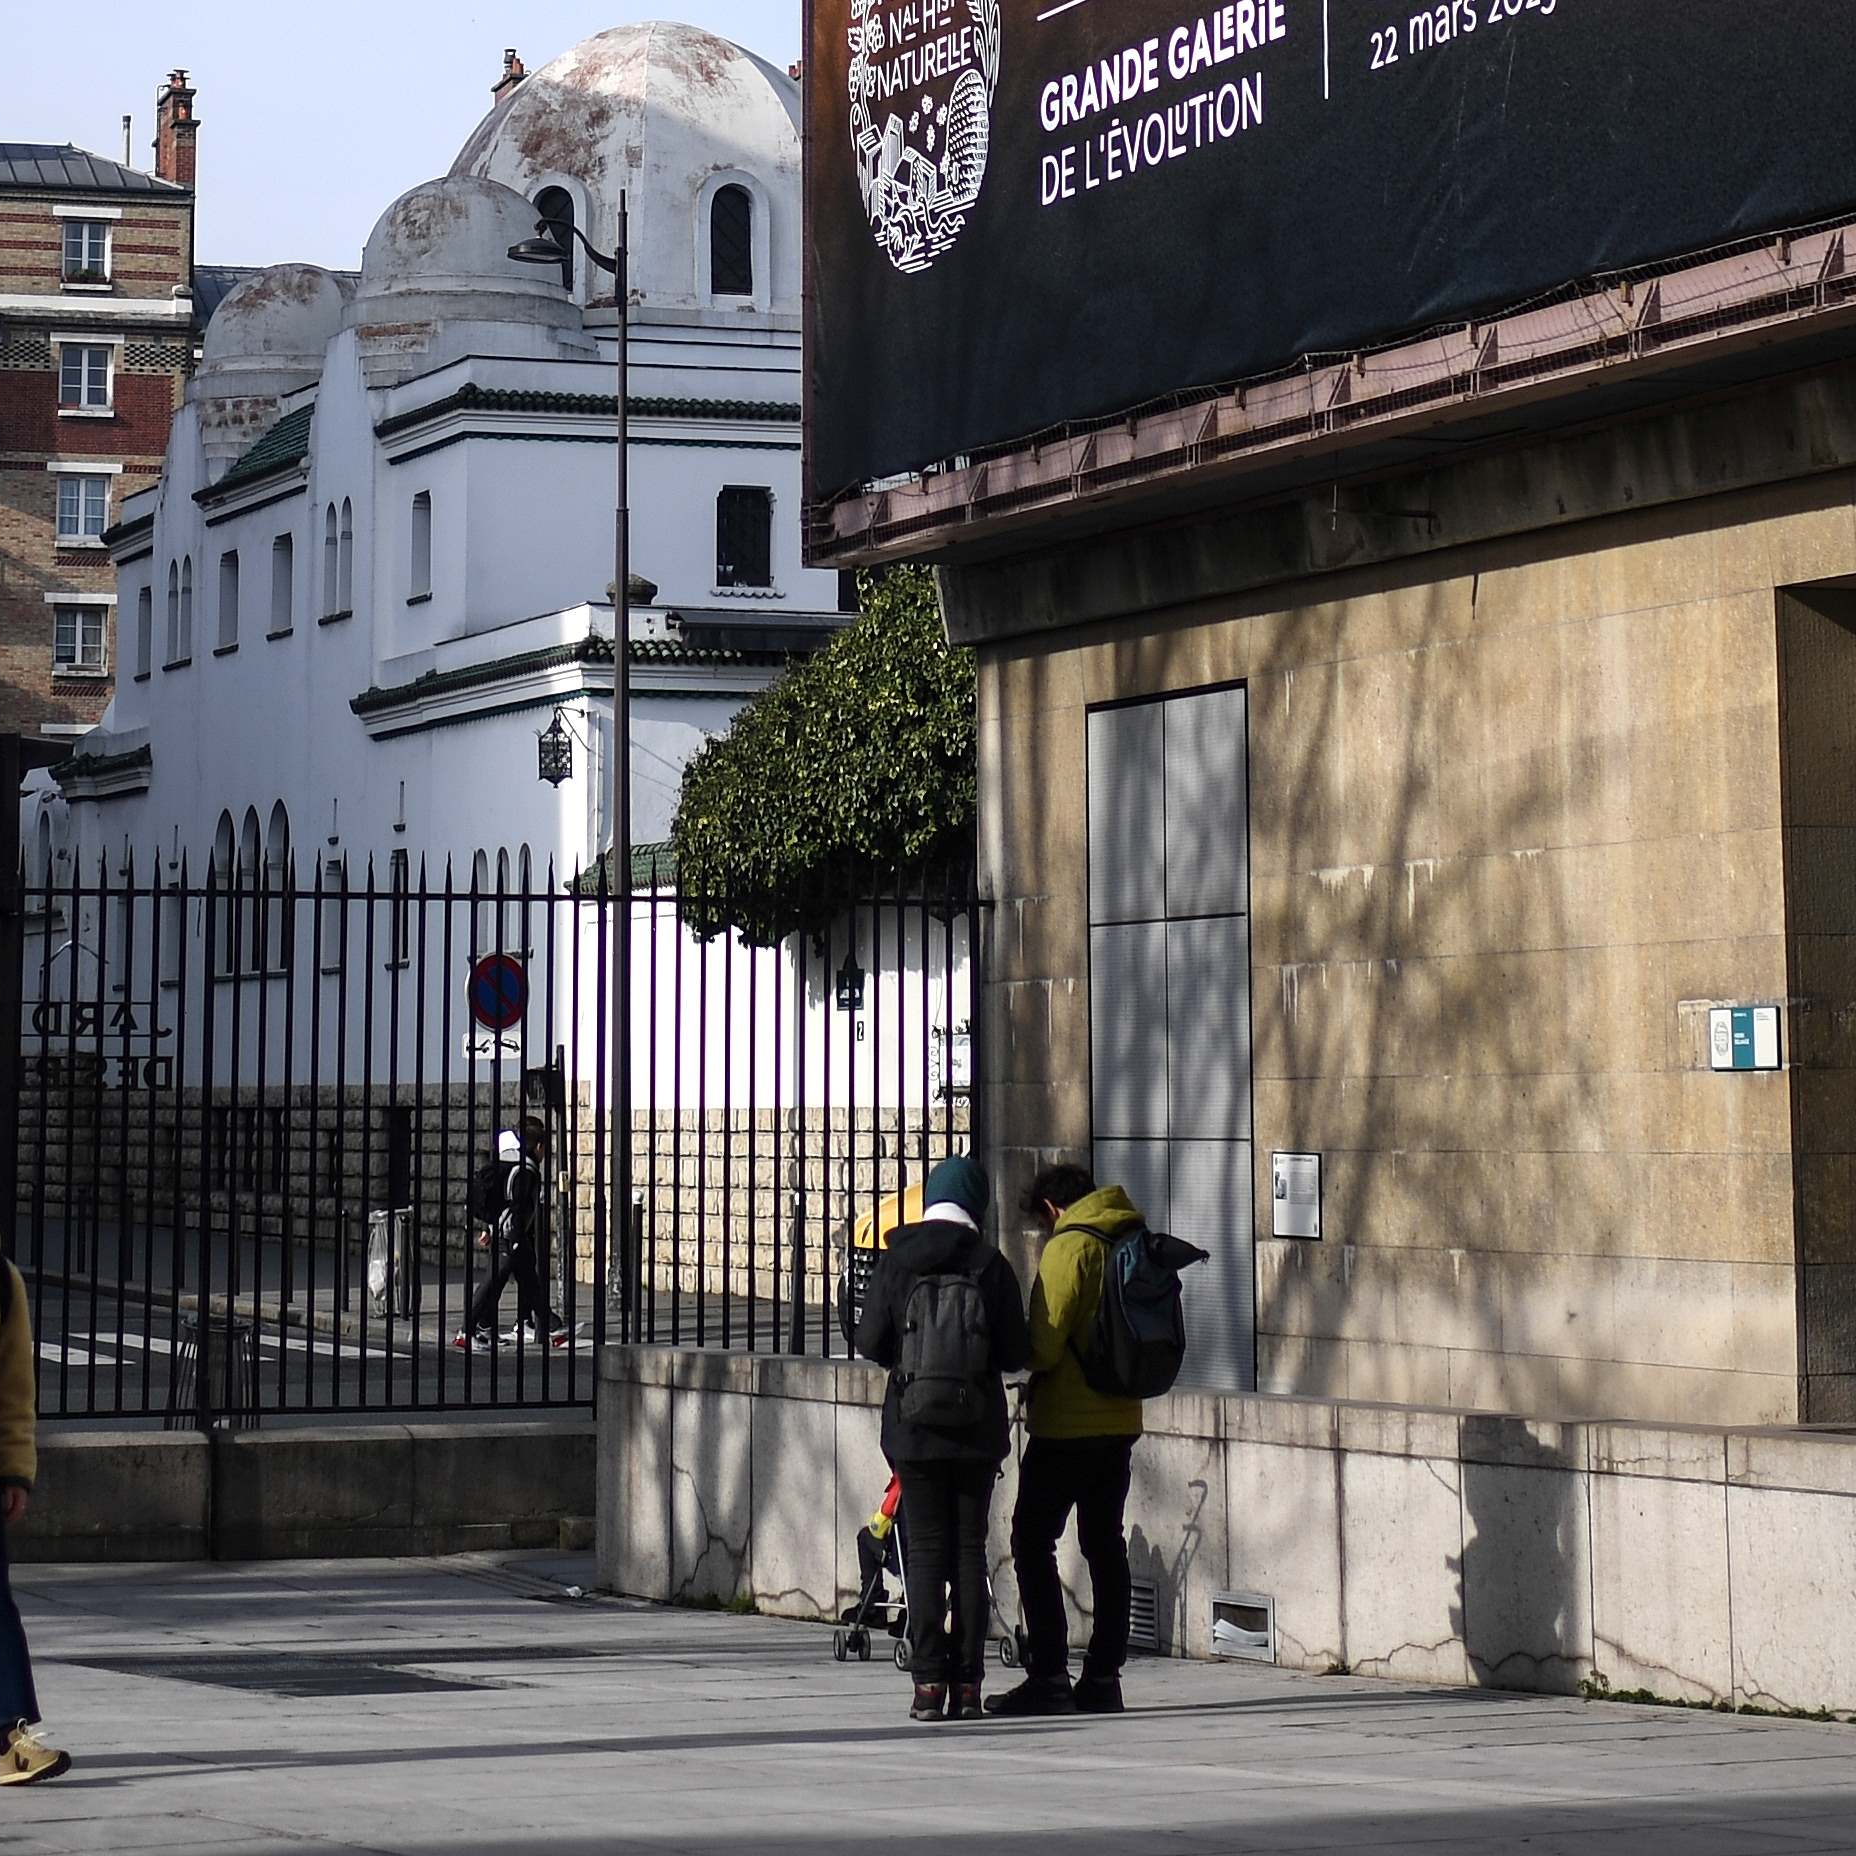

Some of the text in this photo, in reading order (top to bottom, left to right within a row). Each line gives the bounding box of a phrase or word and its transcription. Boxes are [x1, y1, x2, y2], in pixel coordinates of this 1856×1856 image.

[877, 25, 972, 102] NATURELLE
[1369, 25, 1400, 70] 22
[1040, 37, 1159, 132] GRANDE
[1041, 146, 1076, 206] DE
